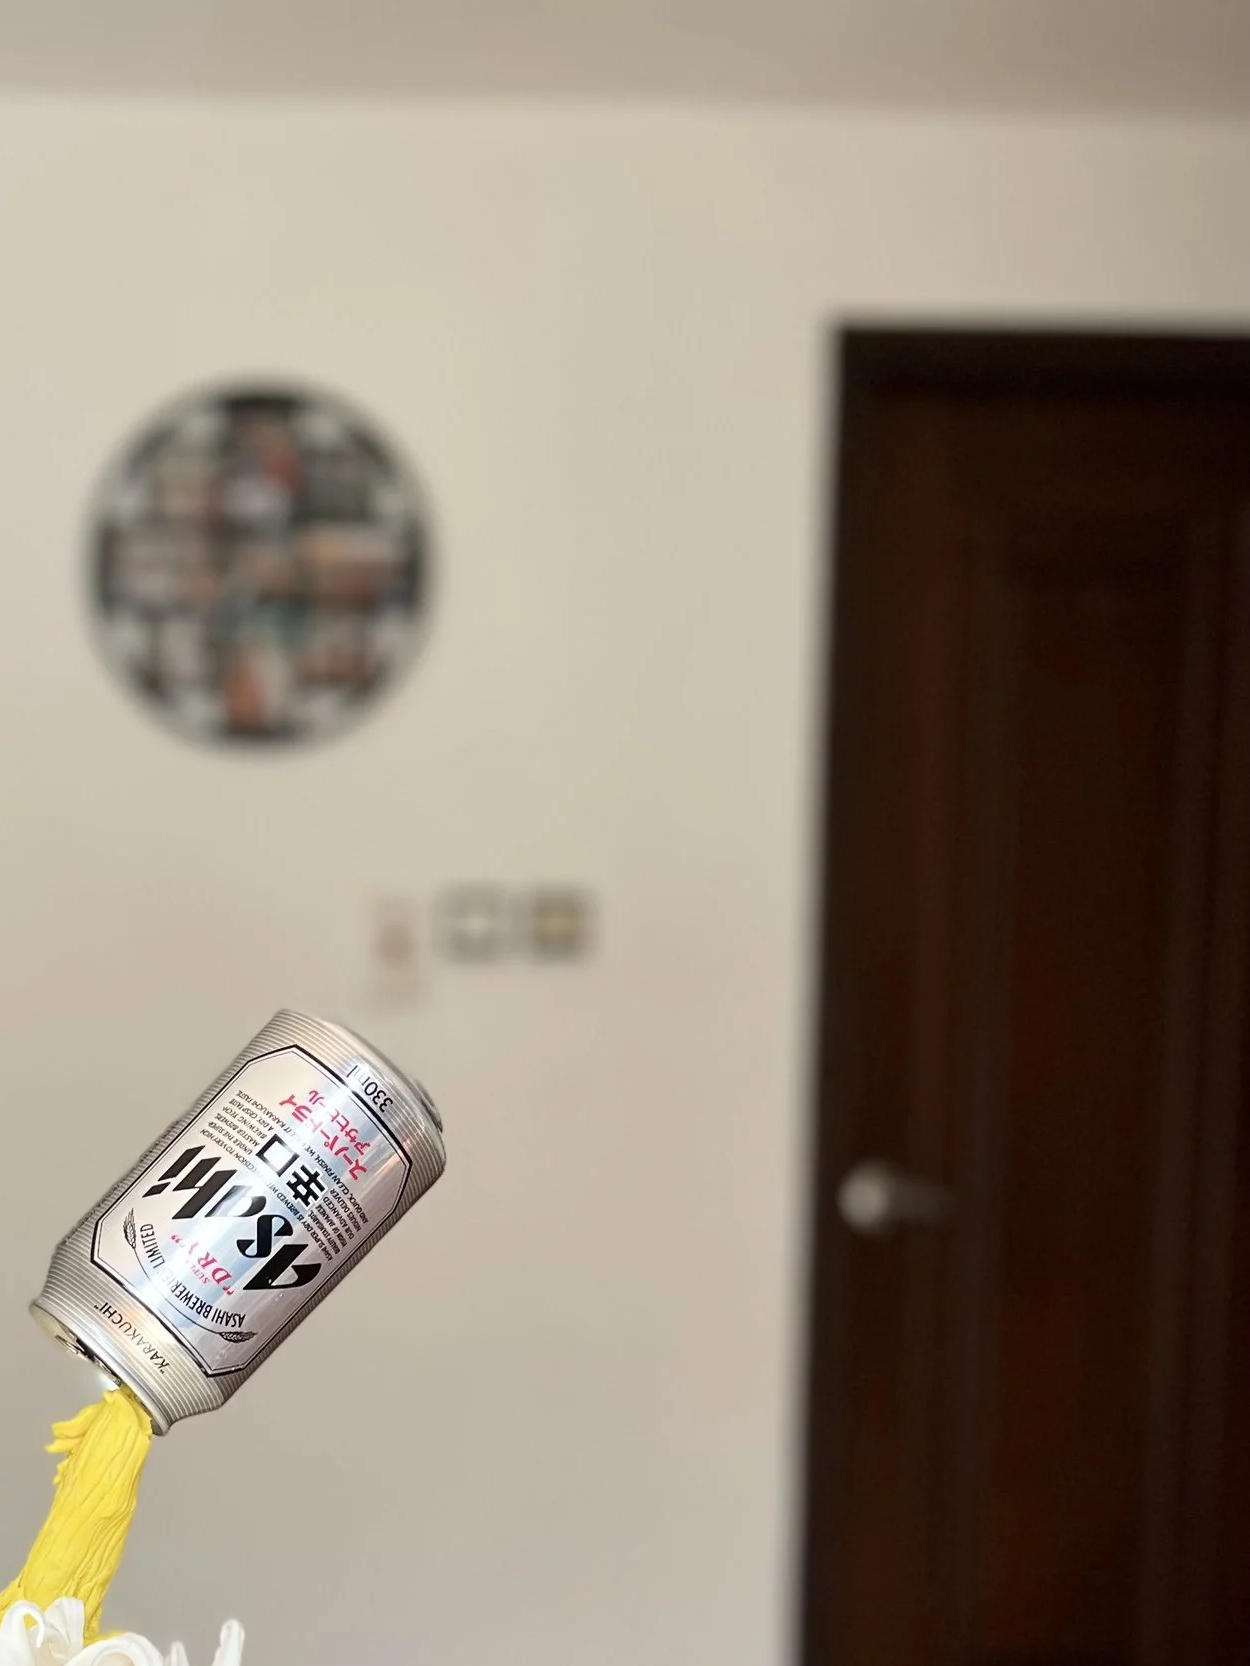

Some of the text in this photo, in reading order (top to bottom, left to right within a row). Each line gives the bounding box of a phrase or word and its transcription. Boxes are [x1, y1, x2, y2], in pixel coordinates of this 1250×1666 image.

[347, 1064, 394, 1114] 330ml
[255, 1133, 324, 1206] 辛口
[275, 1191, 300, 1216] BREWED
[142, 1145, 322, 1291] Asahi
[140, 1223, 246, 1328] ASAHI BREWERIE LIMITED
